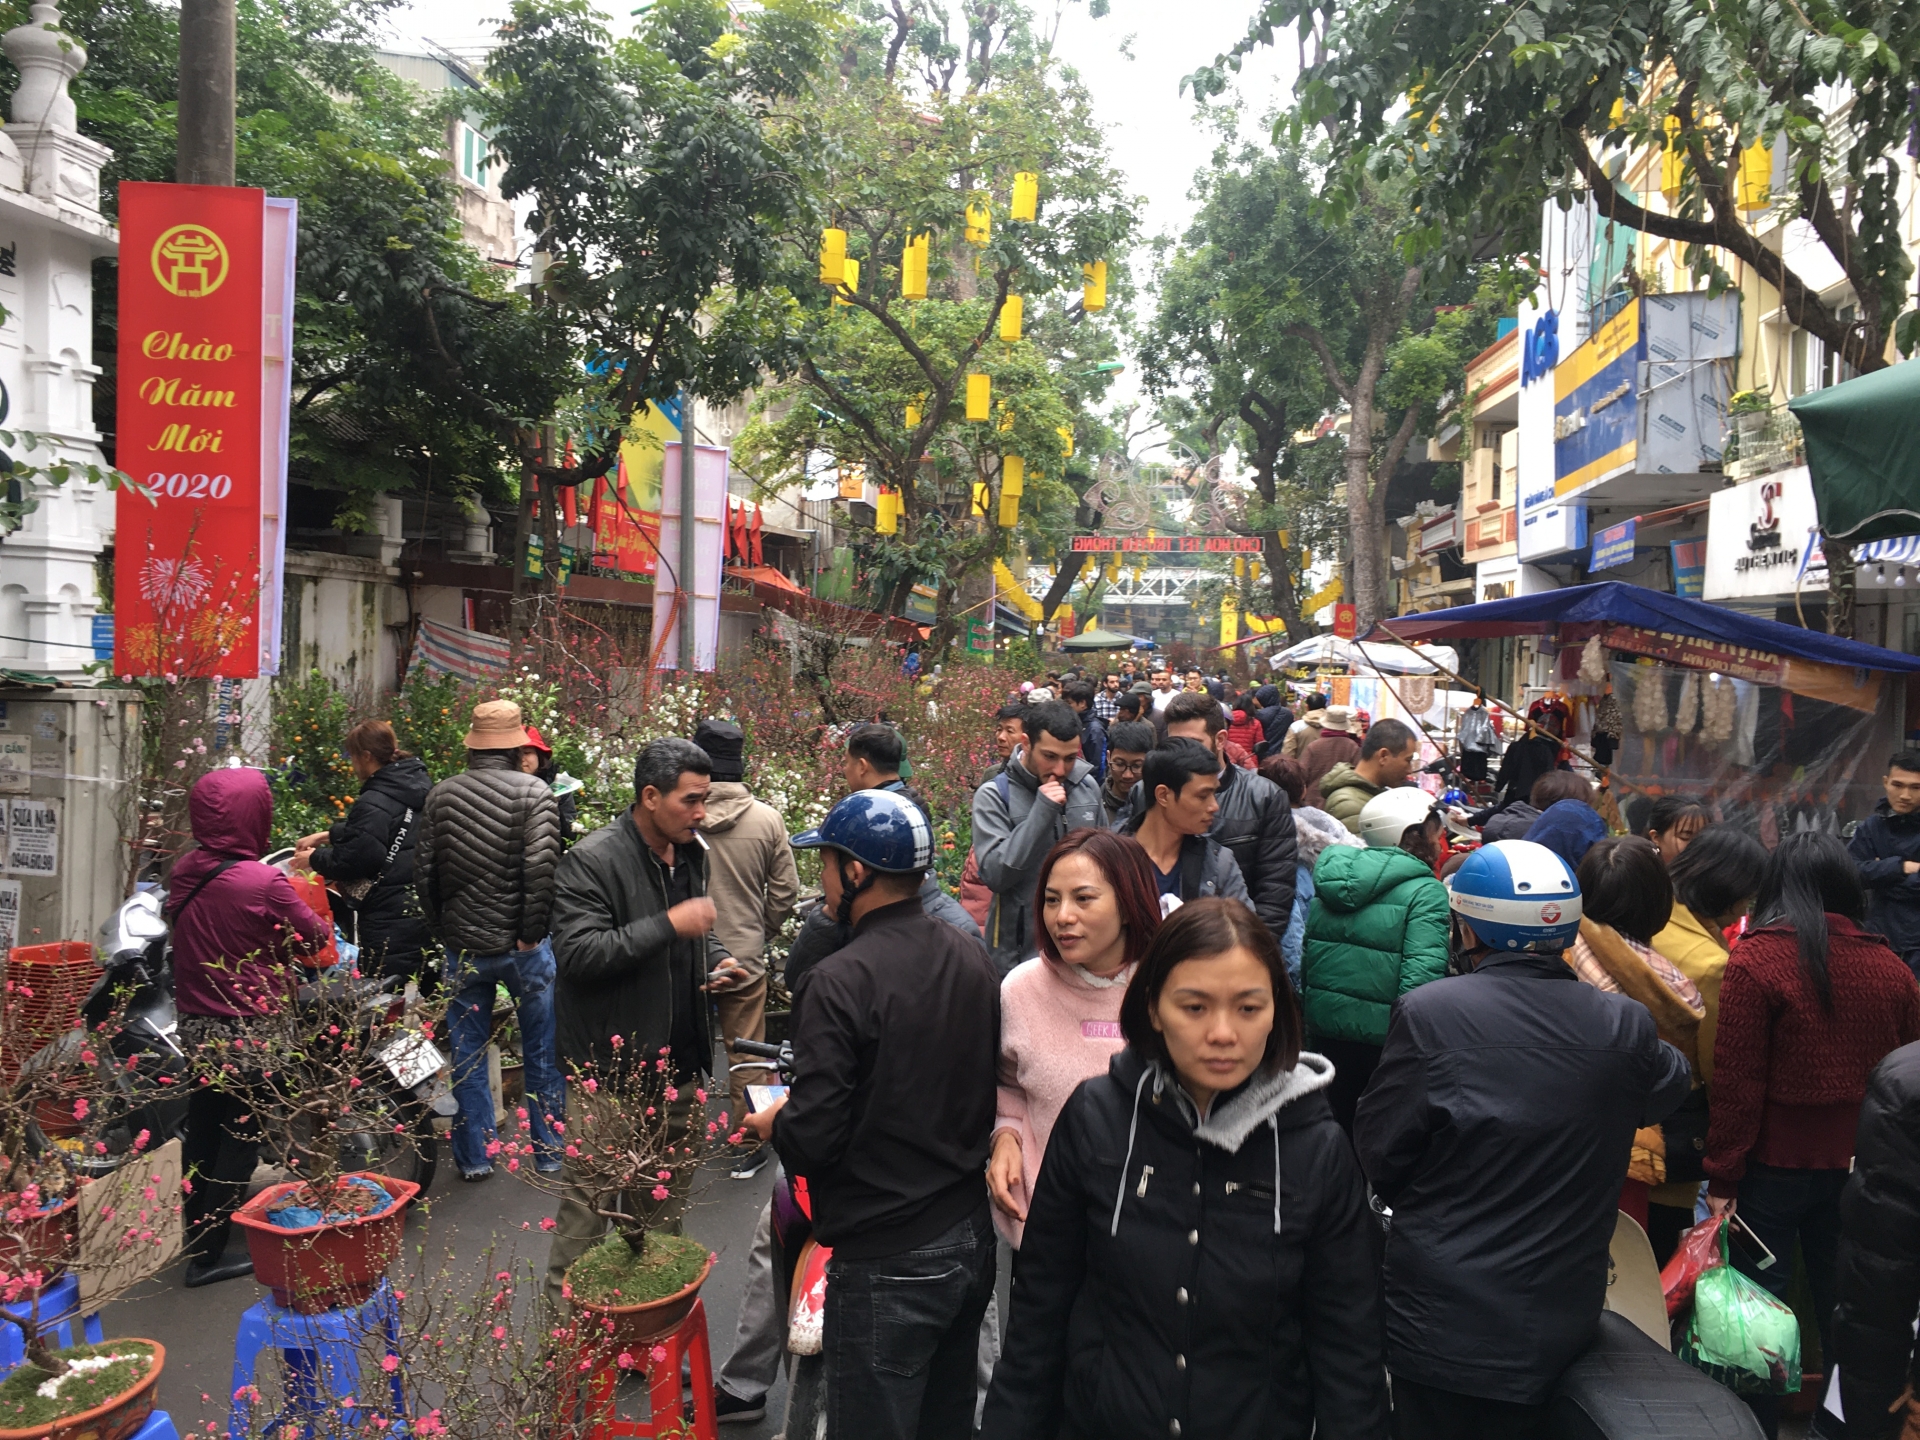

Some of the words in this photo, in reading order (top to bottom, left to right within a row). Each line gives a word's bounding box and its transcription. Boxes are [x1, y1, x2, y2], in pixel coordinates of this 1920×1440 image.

[142, 330, 236, 361] Chào
[1521, 308, 1559, 388] ACB
[139, 376, 238, 407] Năm
[147, 423, 224, 453] Mới
[148, 472, 232, 499] 2020
[1087, 1022, 1109, 1036] GEEK
